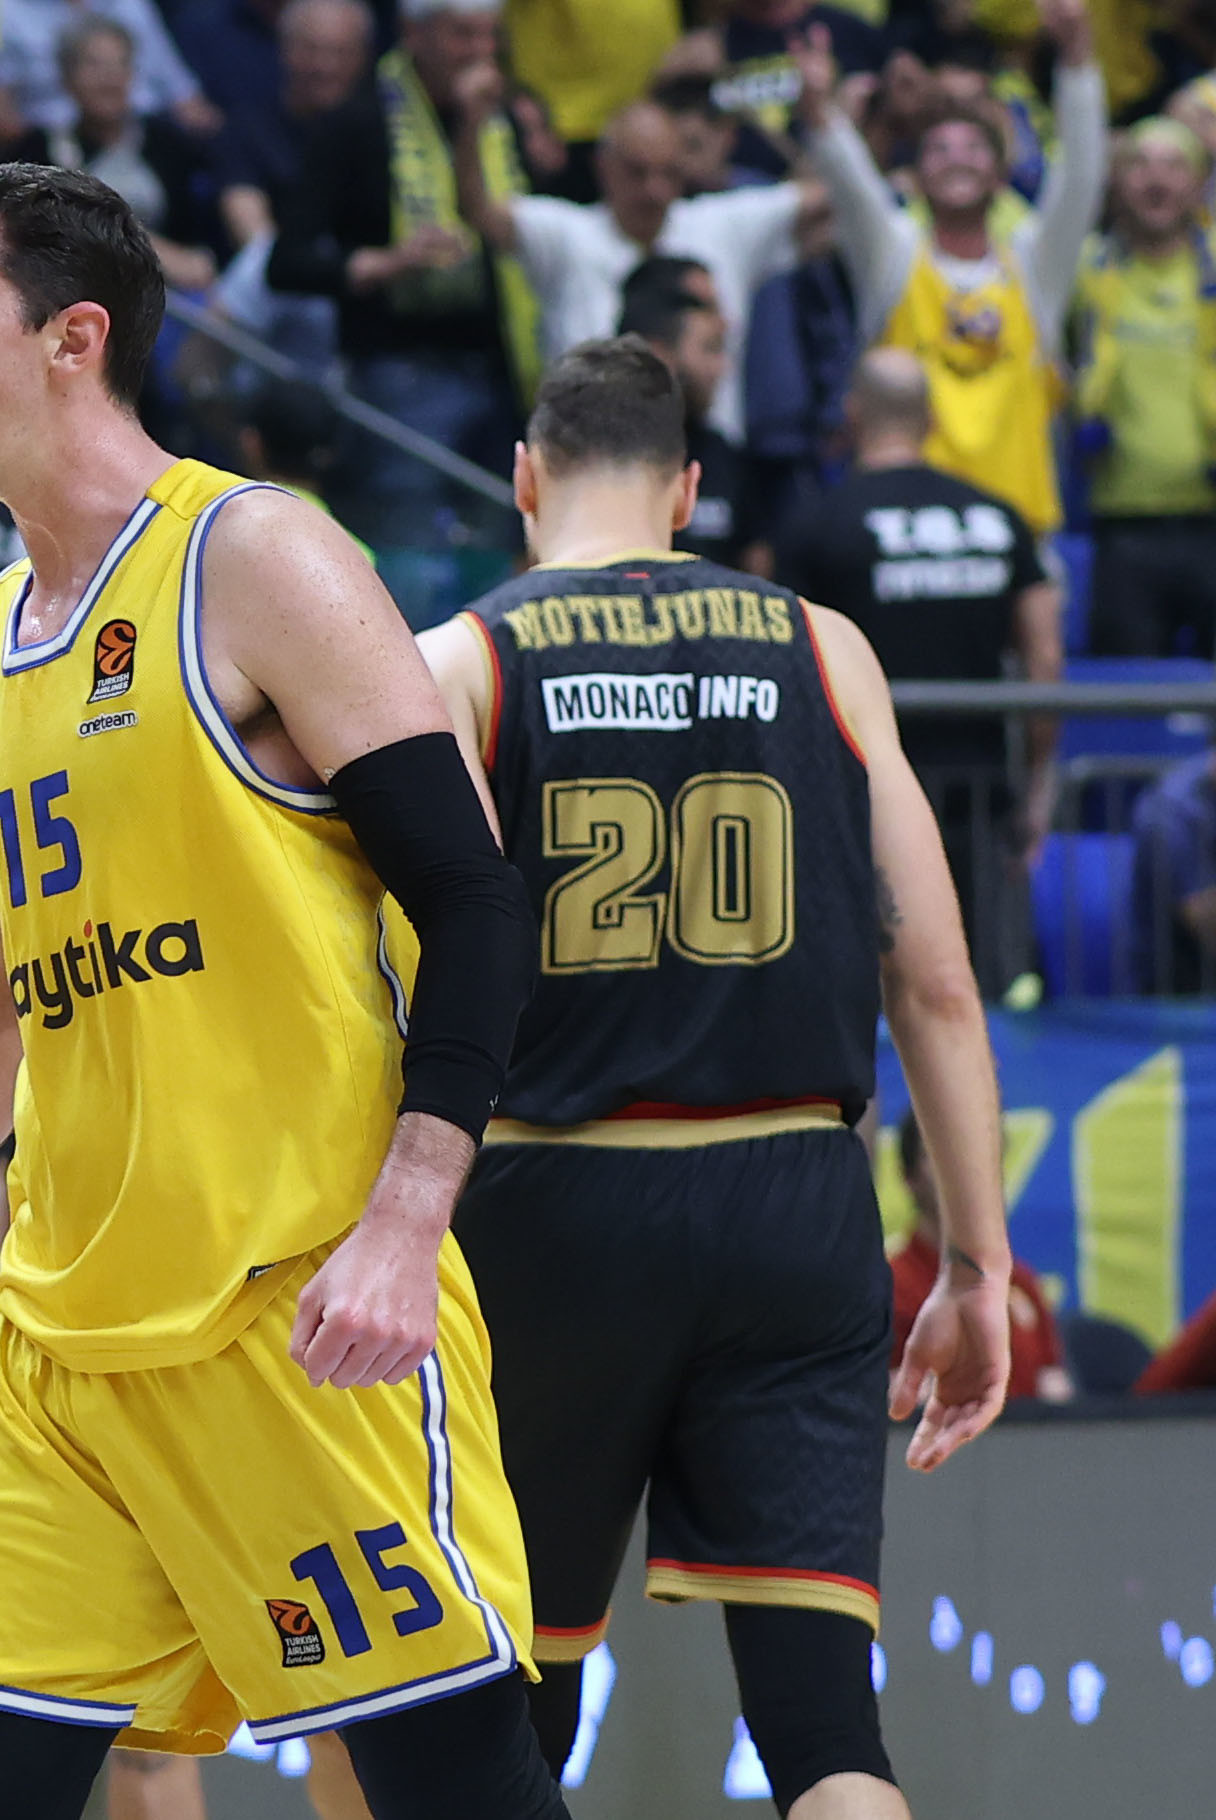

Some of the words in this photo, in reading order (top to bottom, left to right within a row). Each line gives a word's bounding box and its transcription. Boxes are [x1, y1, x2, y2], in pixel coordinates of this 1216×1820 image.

[503, 587, 794, 651] MOTIEJUNAS
[97, 672, 130, 688] TURKISH
[553, 681, 693, 723] MONACO
[698, 675, 779, 722] INFO
[79, 712, 136, 735] oneteam
[541, 770, 795, 975] 20
[290, 1521, 444, 1658] 15
[284, 1633, 320, 1646] TURKISH
[286, 1643, 321, 1656] AIRLINES
